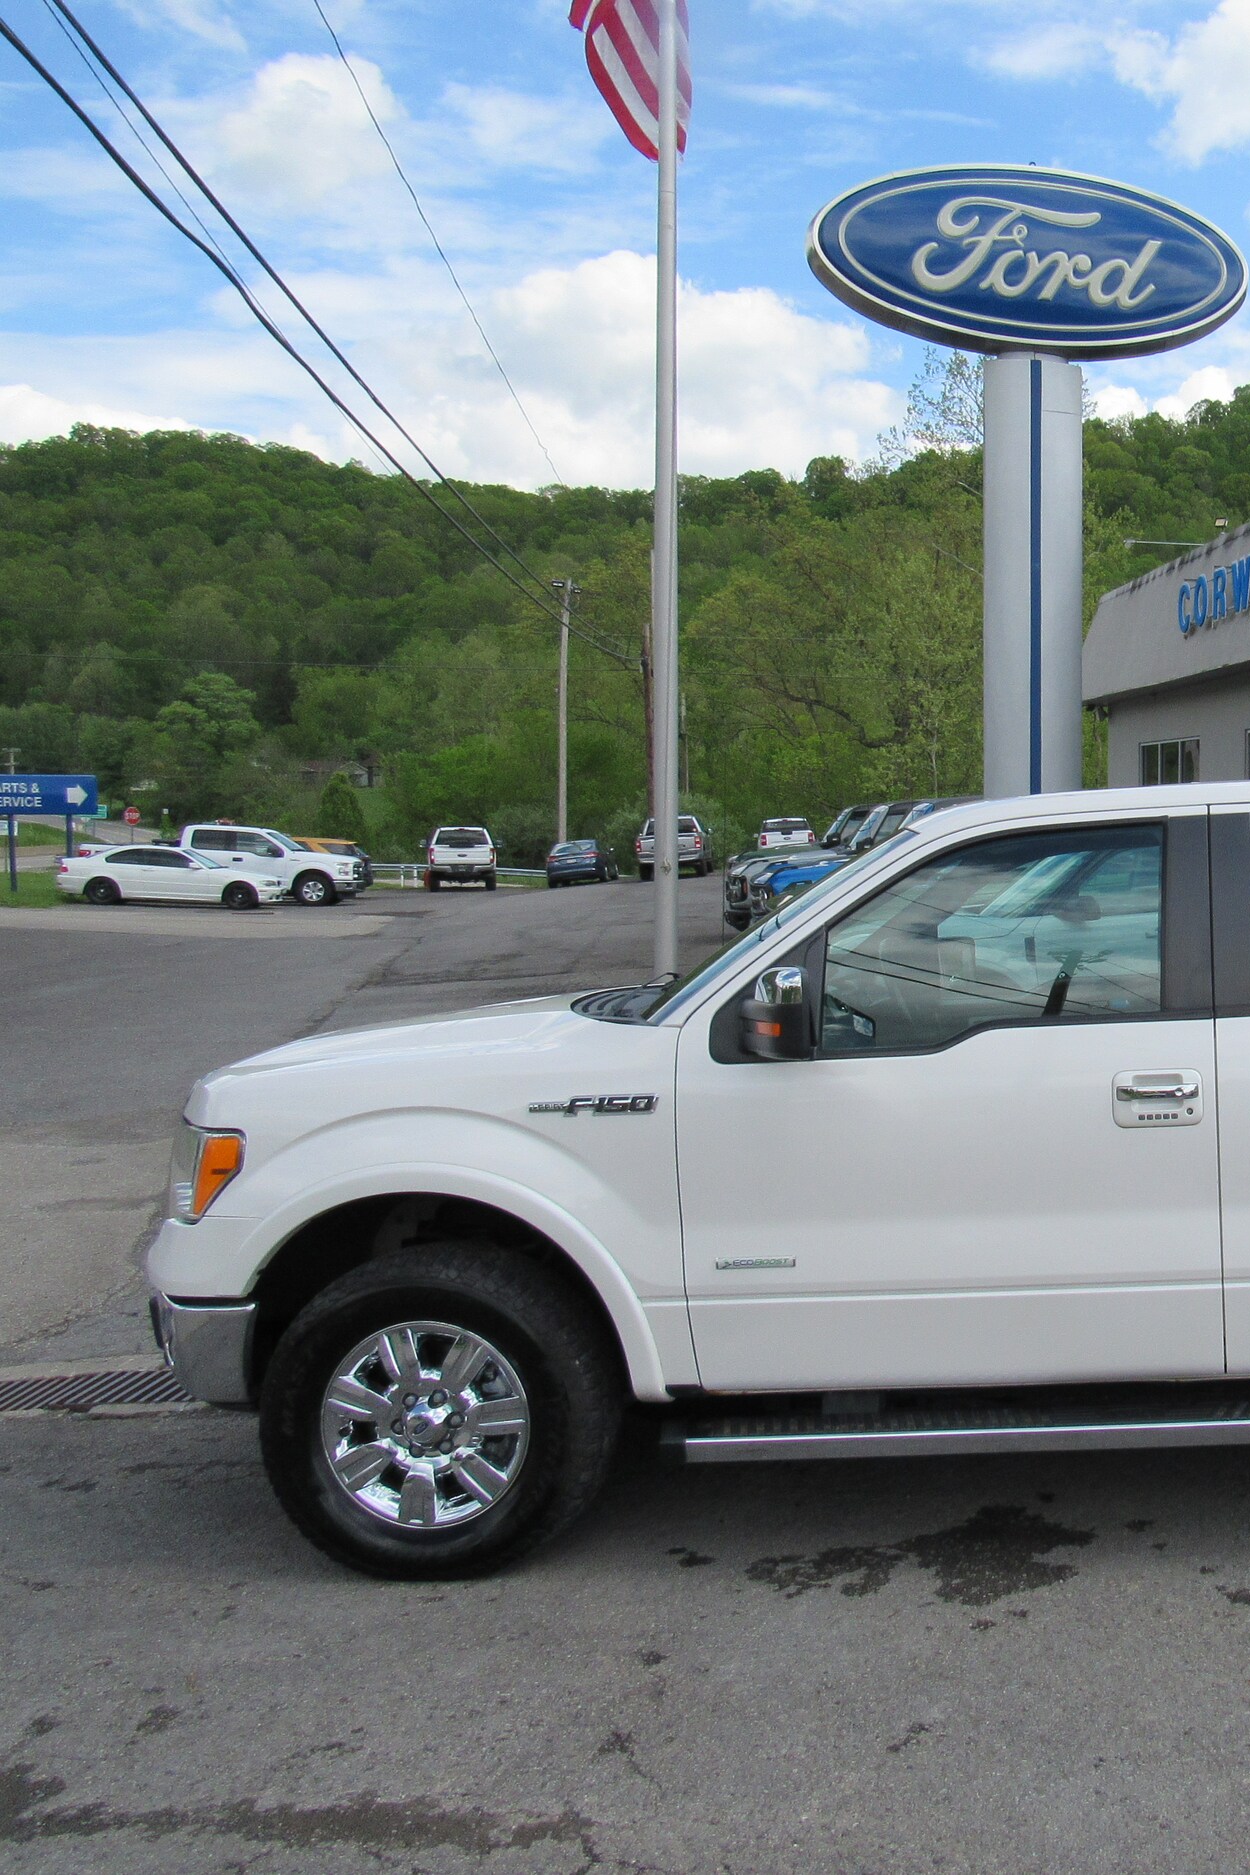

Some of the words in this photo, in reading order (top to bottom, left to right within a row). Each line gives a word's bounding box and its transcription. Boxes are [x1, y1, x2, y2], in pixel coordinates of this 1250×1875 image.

[911, 196, 1163, 310] Ford
[0, 782, 28, 794] RTS
[31, 782, 40, 794] &
